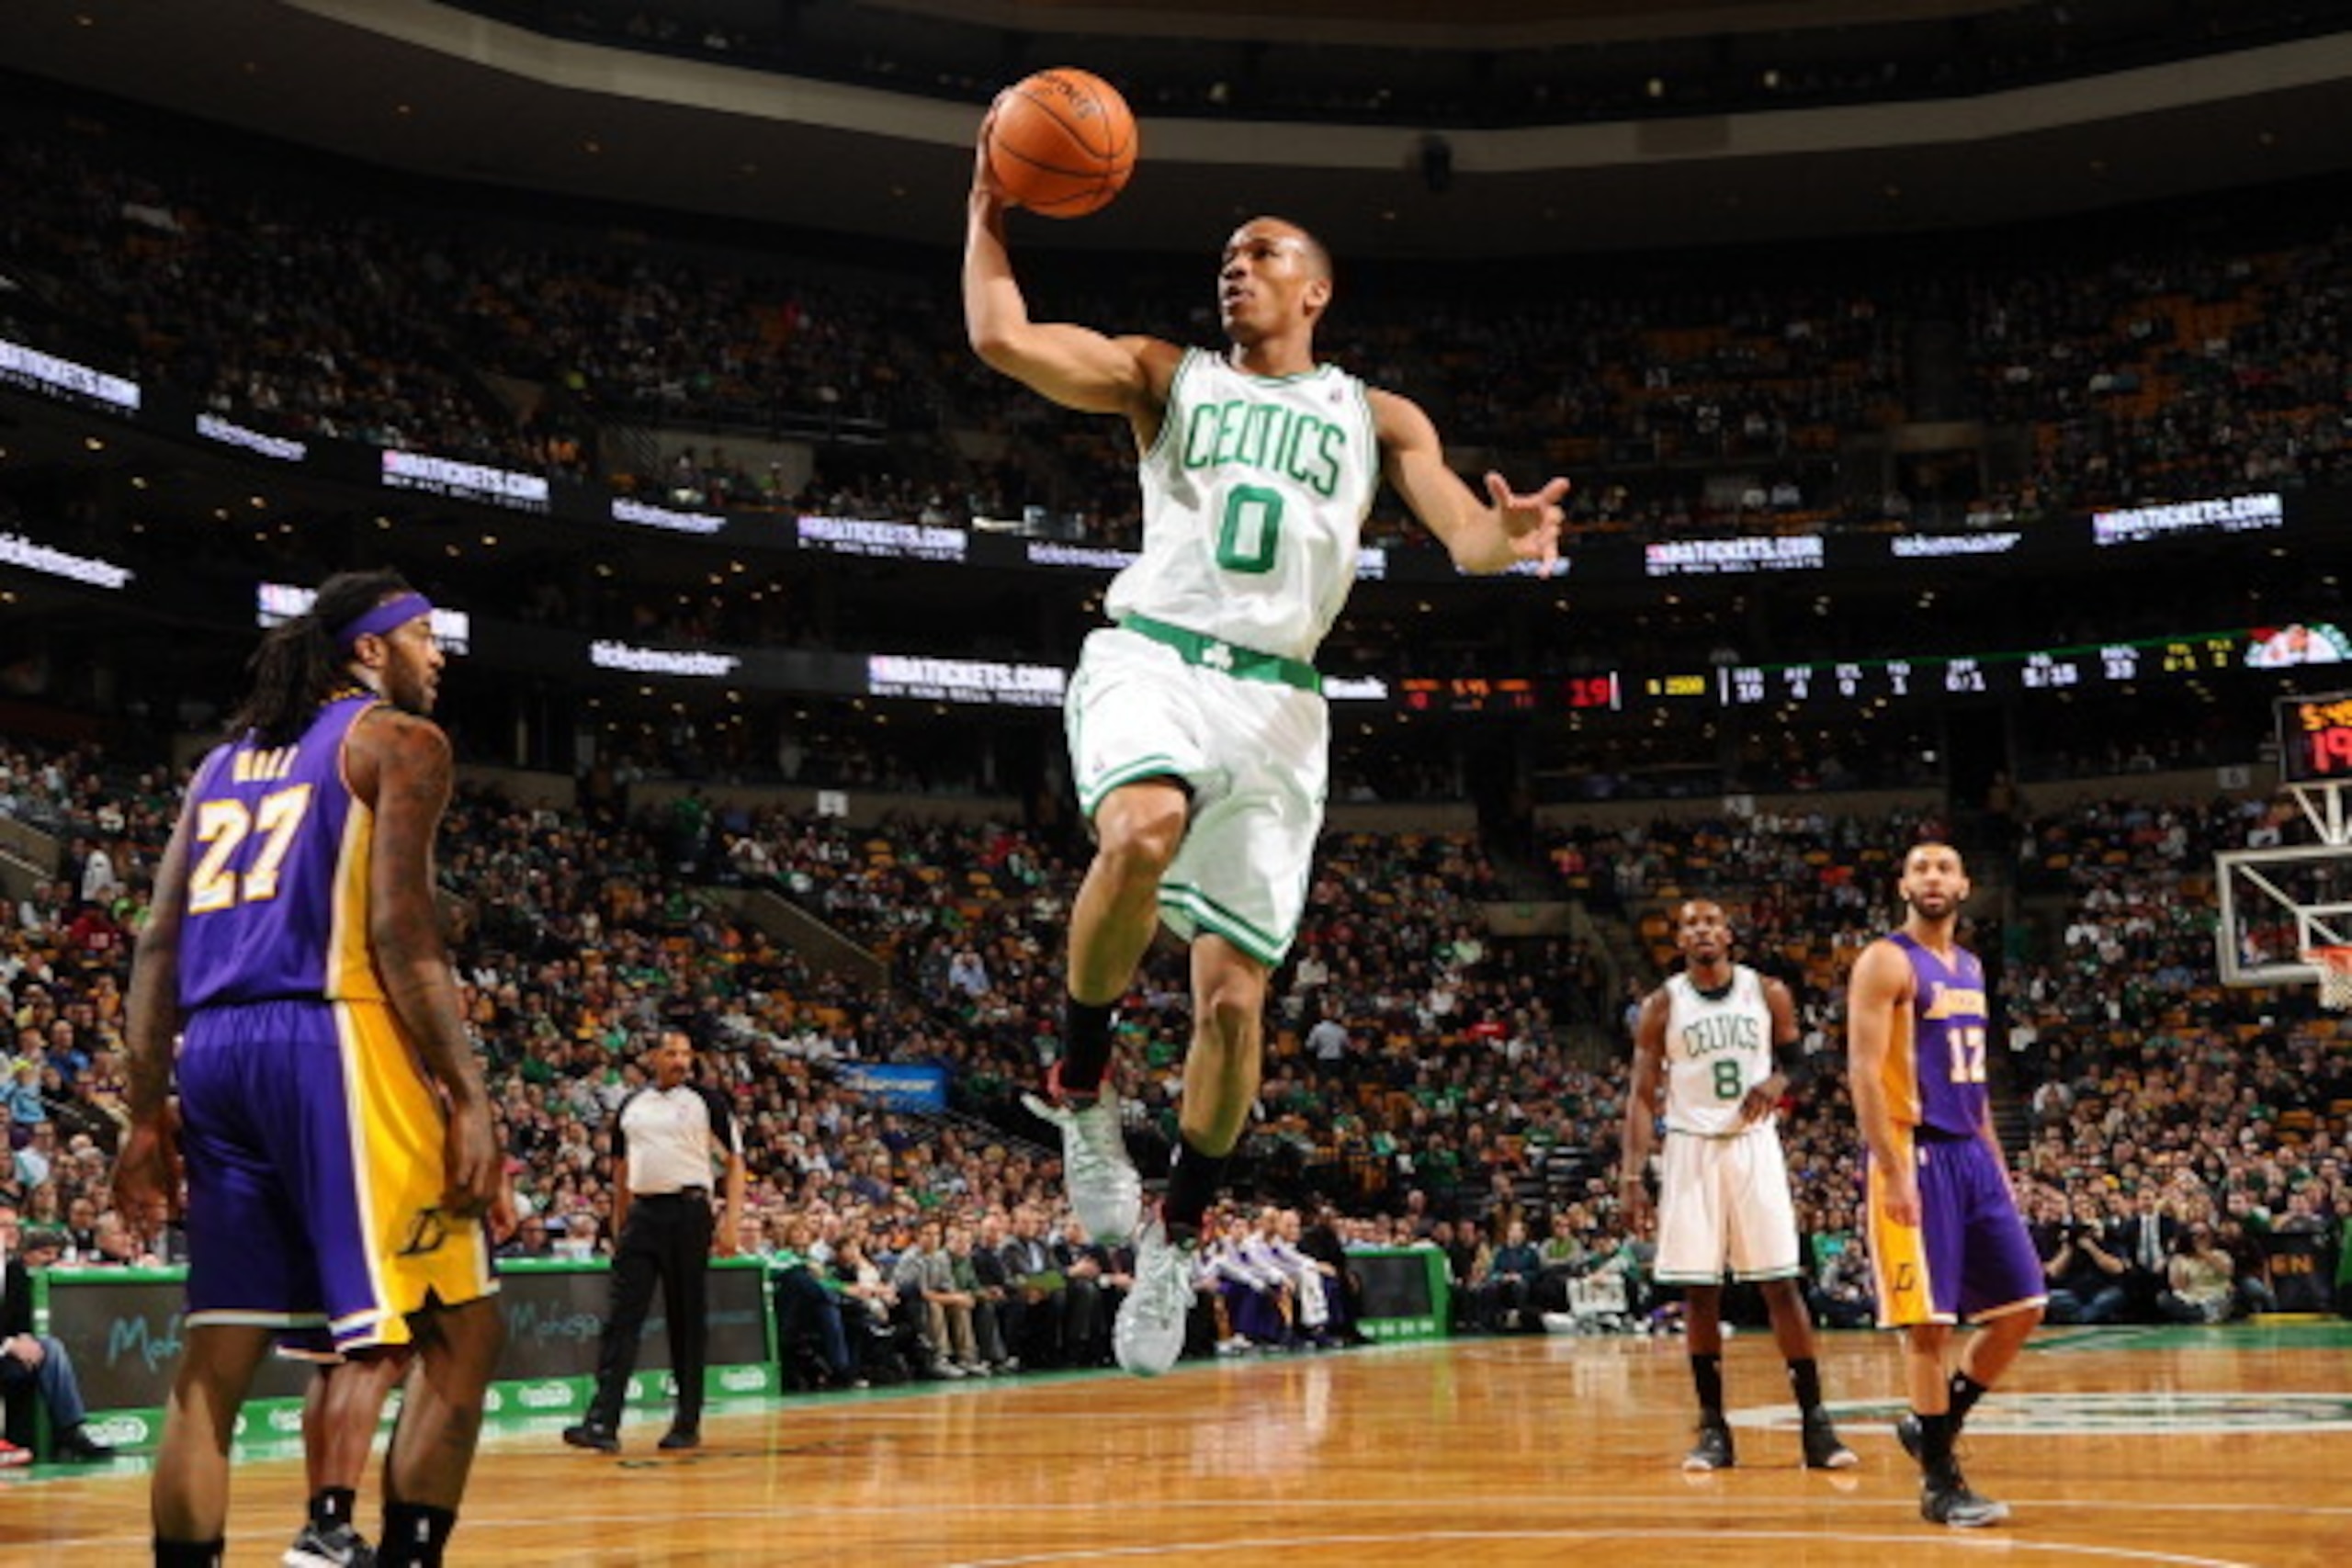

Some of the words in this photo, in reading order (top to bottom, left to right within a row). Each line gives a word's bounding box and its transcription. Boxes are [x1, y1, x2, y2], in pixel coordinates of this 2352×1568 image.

[1183, 400, 1346, 498] CELTICS
[1216, 483, 1283, 573] 0
[590, 639, 741, 675] ticketmaster
[888, 657, 1064, 694] NBATICKETS.COM
[188, 784, 312, 915] 27
[1682, 1013, 1759, 1058] CELTICS
[1714, 1059, 1742, 1100] 8
